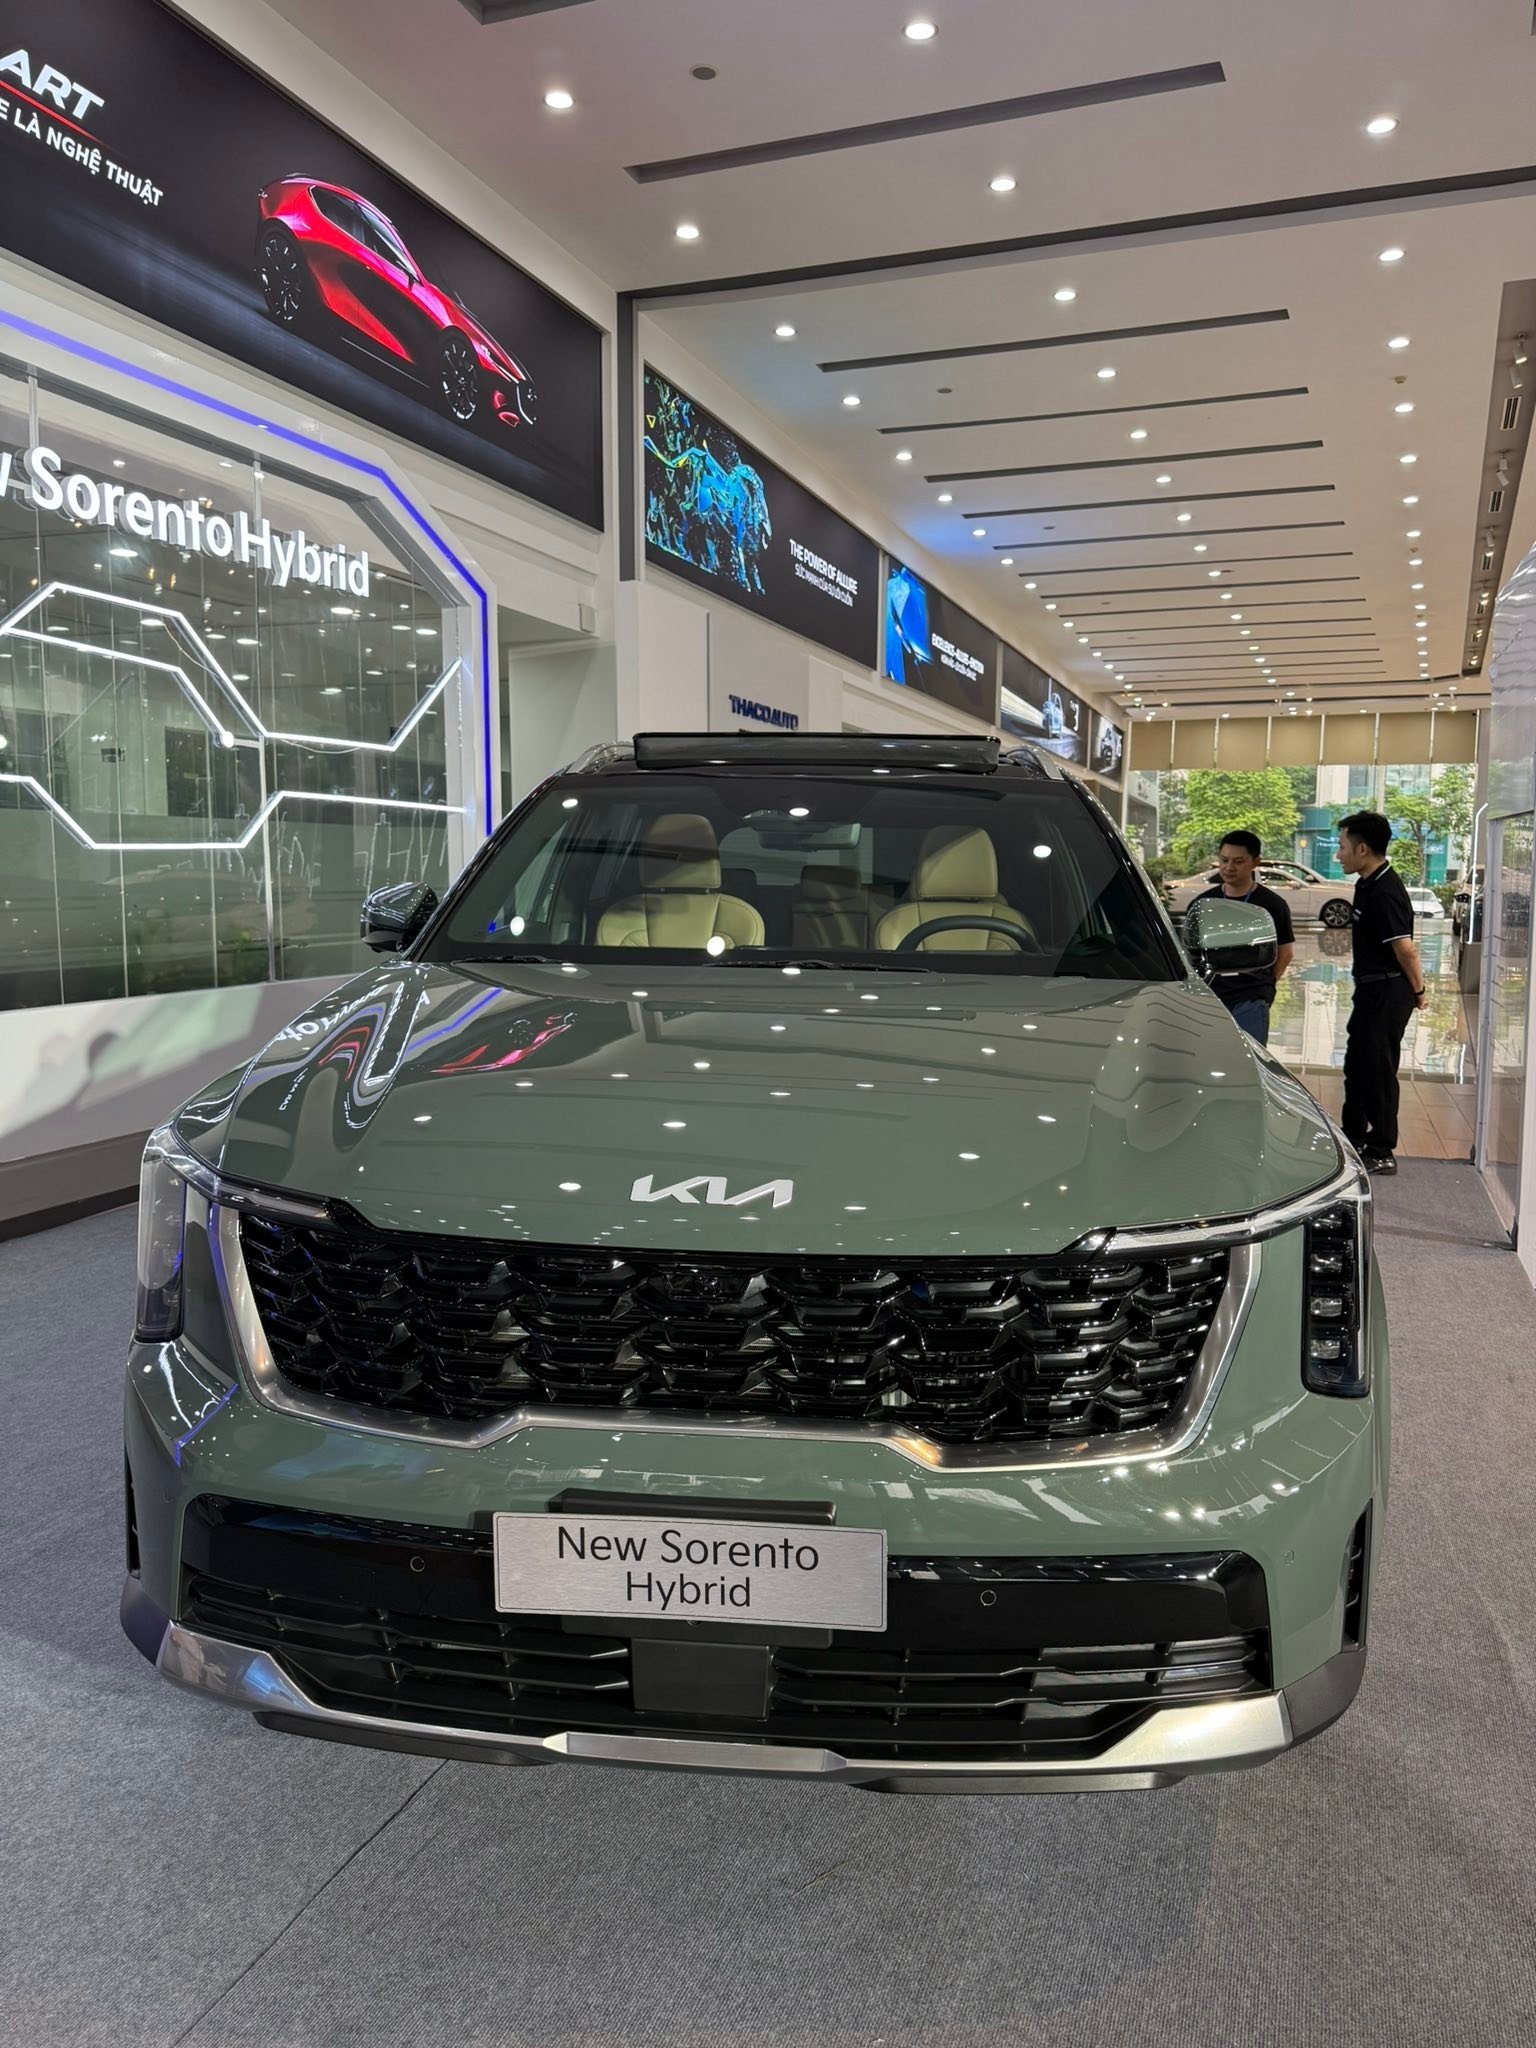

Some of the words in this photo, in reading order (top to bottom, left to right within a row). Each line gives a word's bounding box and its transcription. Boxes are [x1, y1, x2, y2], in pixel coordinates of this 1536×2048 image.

[0, 49, 105, 120] ART
[14, 107, 41, 139] LÀ
[46, 125, 102, 175] NGHỆ
[105, 159, 164, 207] THUẬT
[27, 446, 234, 557] Sorento
[237, 510, 370, 598] Hybrid
[789, 538, 804, 561] THE
[803, 547, 828, 576] POWER
[828, 563, 837, 580] OF
[836, 569, 858, 595] ALLURE
[630, 1174, 794, 1208] KIA
[558, 1526, 647, 1561] New
[660, 1530, 819, 1570] Sorento
[626, 1571, 751, 1611] Hybrid
